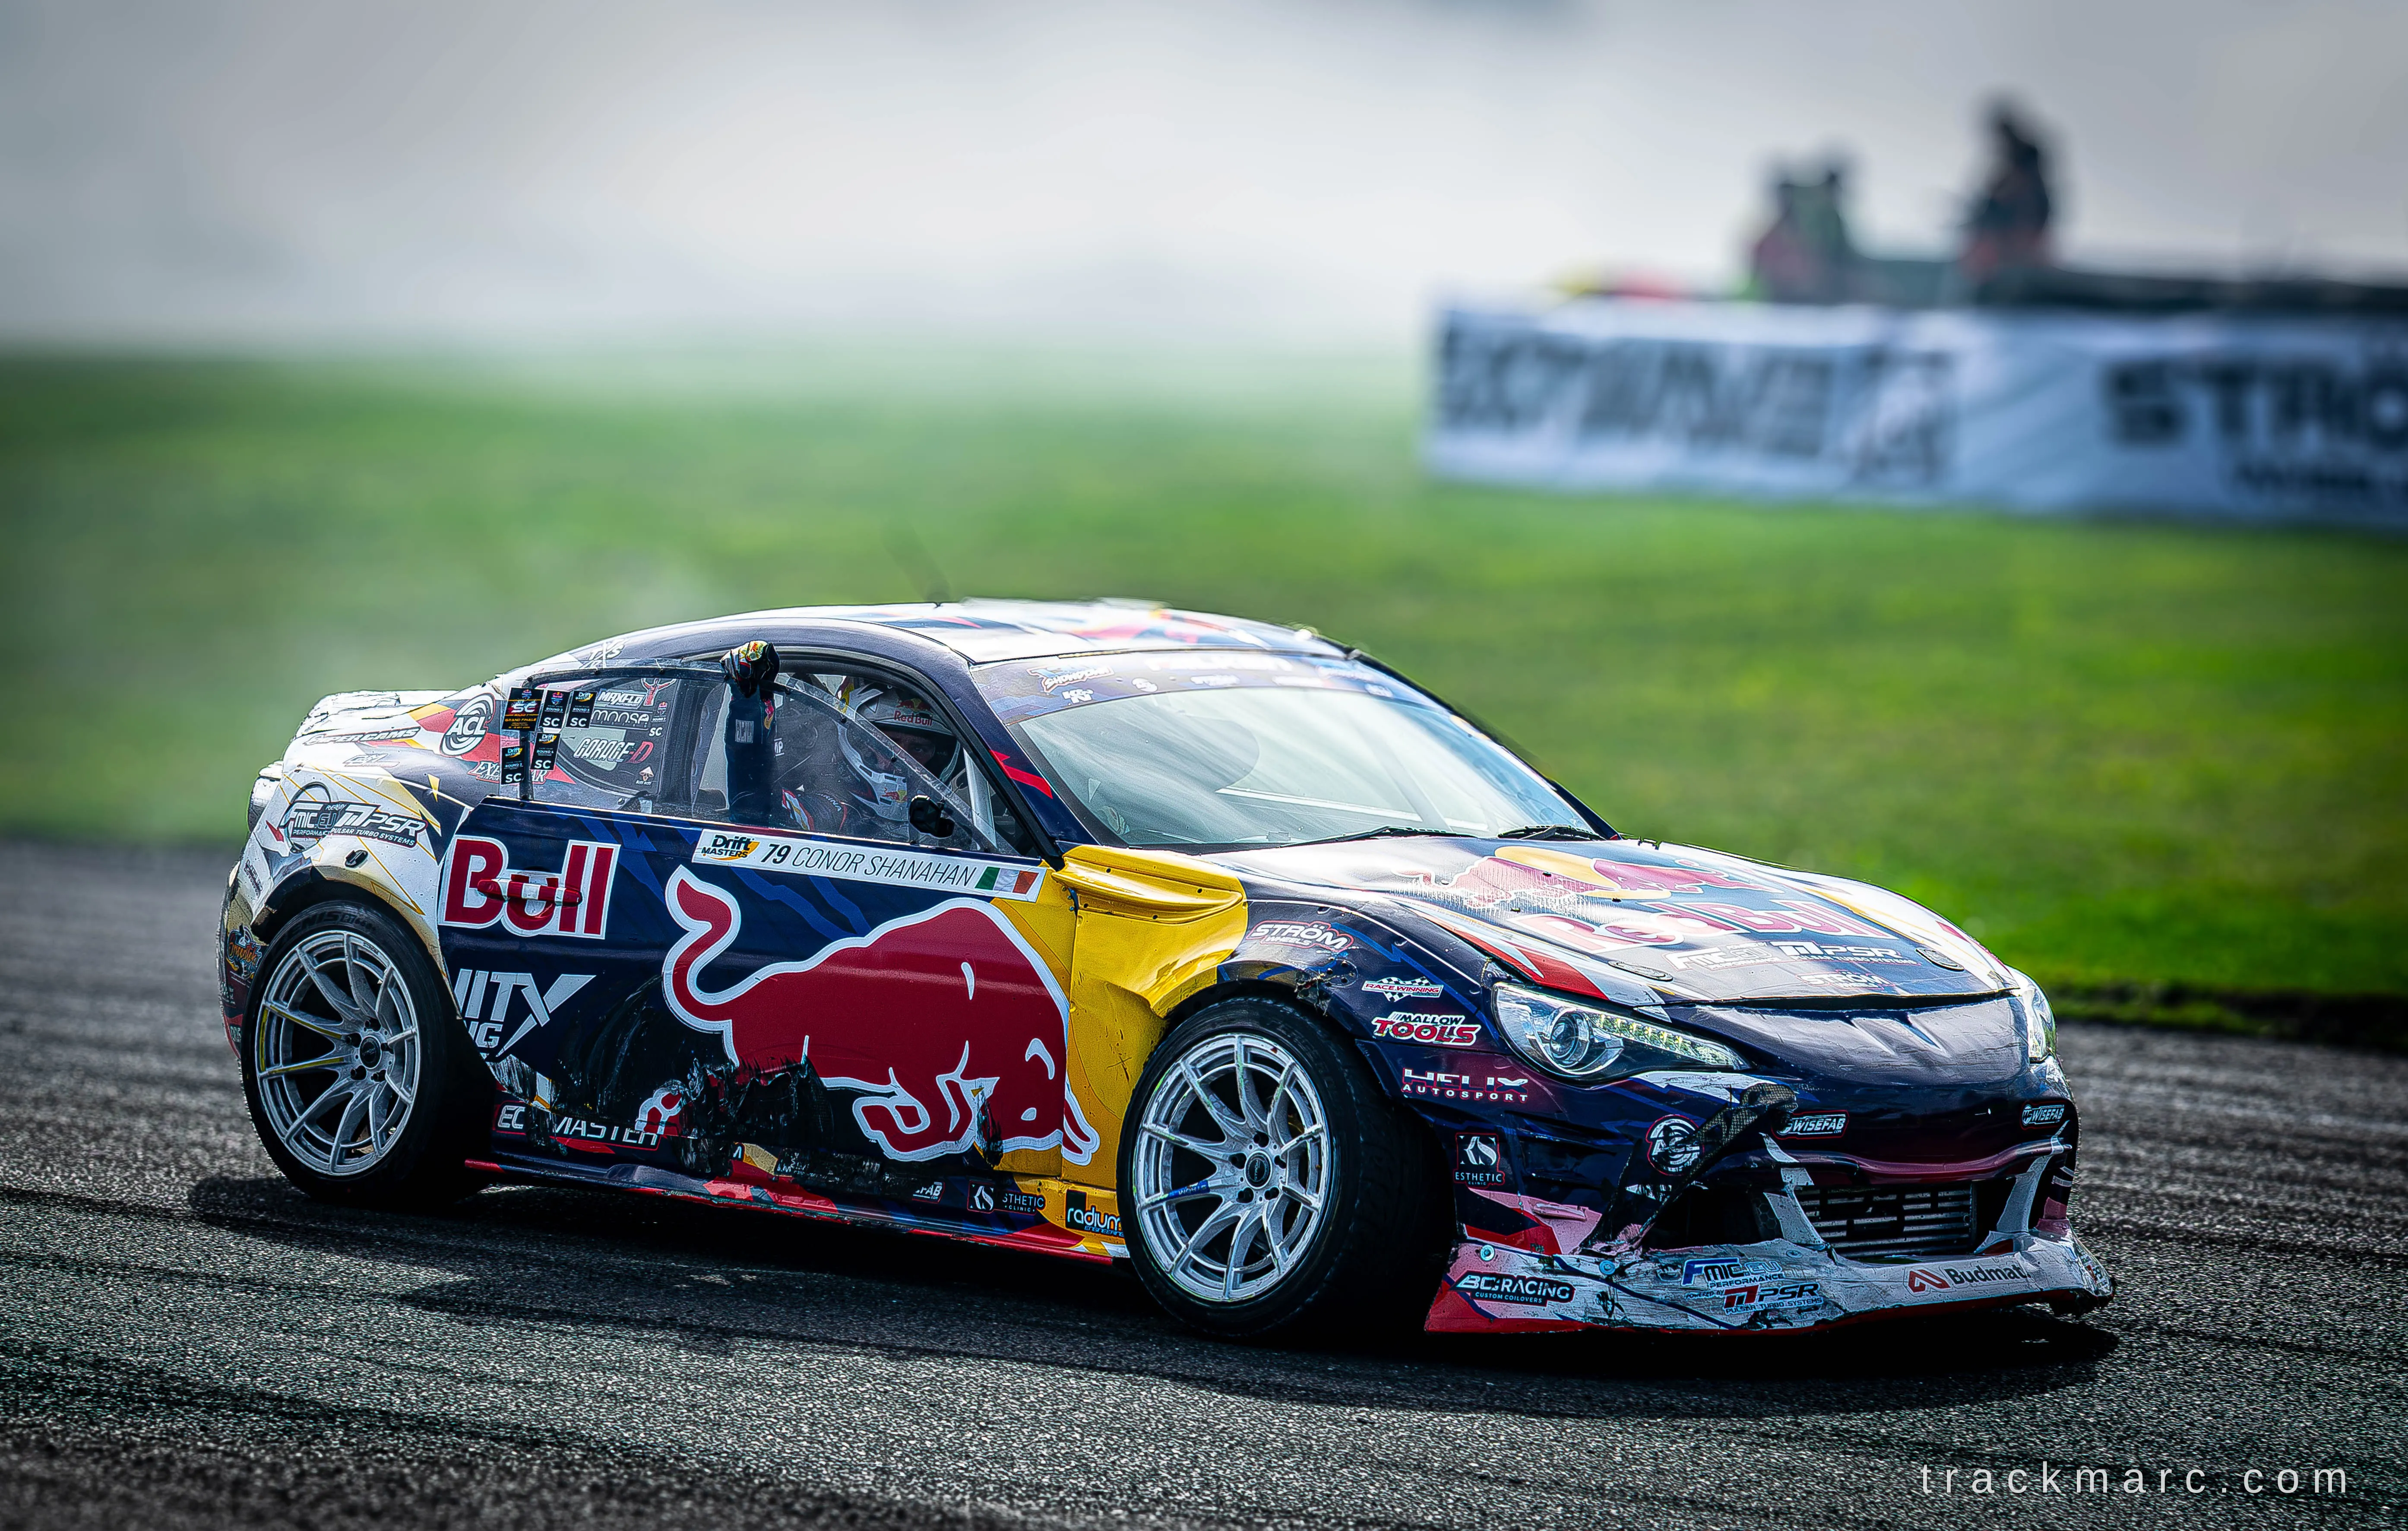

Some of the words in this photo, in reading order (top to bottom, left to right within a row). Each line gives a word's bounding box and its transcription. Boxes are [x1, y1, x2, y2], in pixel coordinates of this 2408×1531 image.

[598, 691, 645, 705] MAXFLO
[511, 703, 537, 713] SC
[543, 717, 560, 727] SC
[570, 717, 587, 727] SC
[894, 709, 914, 723] Red
[445, 716, 487, 735] ACL
[649, 727, 663, 737] SC
[534, 760, 551, 769] SC
[505, 773, 522, 783] SC
[364, 814, 425, 837] PSR
[355, 829, 379, 837] TURBO
[380, 833, 415, 846] SYSTEMS
[712, 835, 751, 850] Drift
[701, 846, 749, 859] MASTERS
[760, 843, 792, 864] 79
[792, 846, 865, 875] CONOR
[864, 856, 976, 887] SHANAHAN
[441, 836, 617, 937] Bull
[1251, 924, 1348, 949] STRÖM
[1265, 936, 1312, 946] WHEELS
[1819, 945, 1903, 958] PSR
[1400, 1014, 1463, 1025] MALLOW
[1374, 1019, 1479, 1043] TOOLS
[1402, 1084, 1528, 1101] AUTOSPORT
[2032, 1108, 2065, 1122] WISEFAB
[1793, 1118, 1846, 1132] WISEFAB
[1455, 1172, 1502, 1182] ESTHETIC
[1067, 1207, 1121, 1231] radium
[1709, 1273, 1785, 1289] PERFORMANCE
[1500, 1278, 1570, 1299] RACING
[1757, 1283, 1820, 1303] PSR
[1504, 1295, 1542, 1303] COILOVERS
[1726, 1304, 1756, 1315] PULSAR
[1760, 1301, 1785, 1309] TURBO
[1787, 1297, 1823, 1307] SYSTEMS
